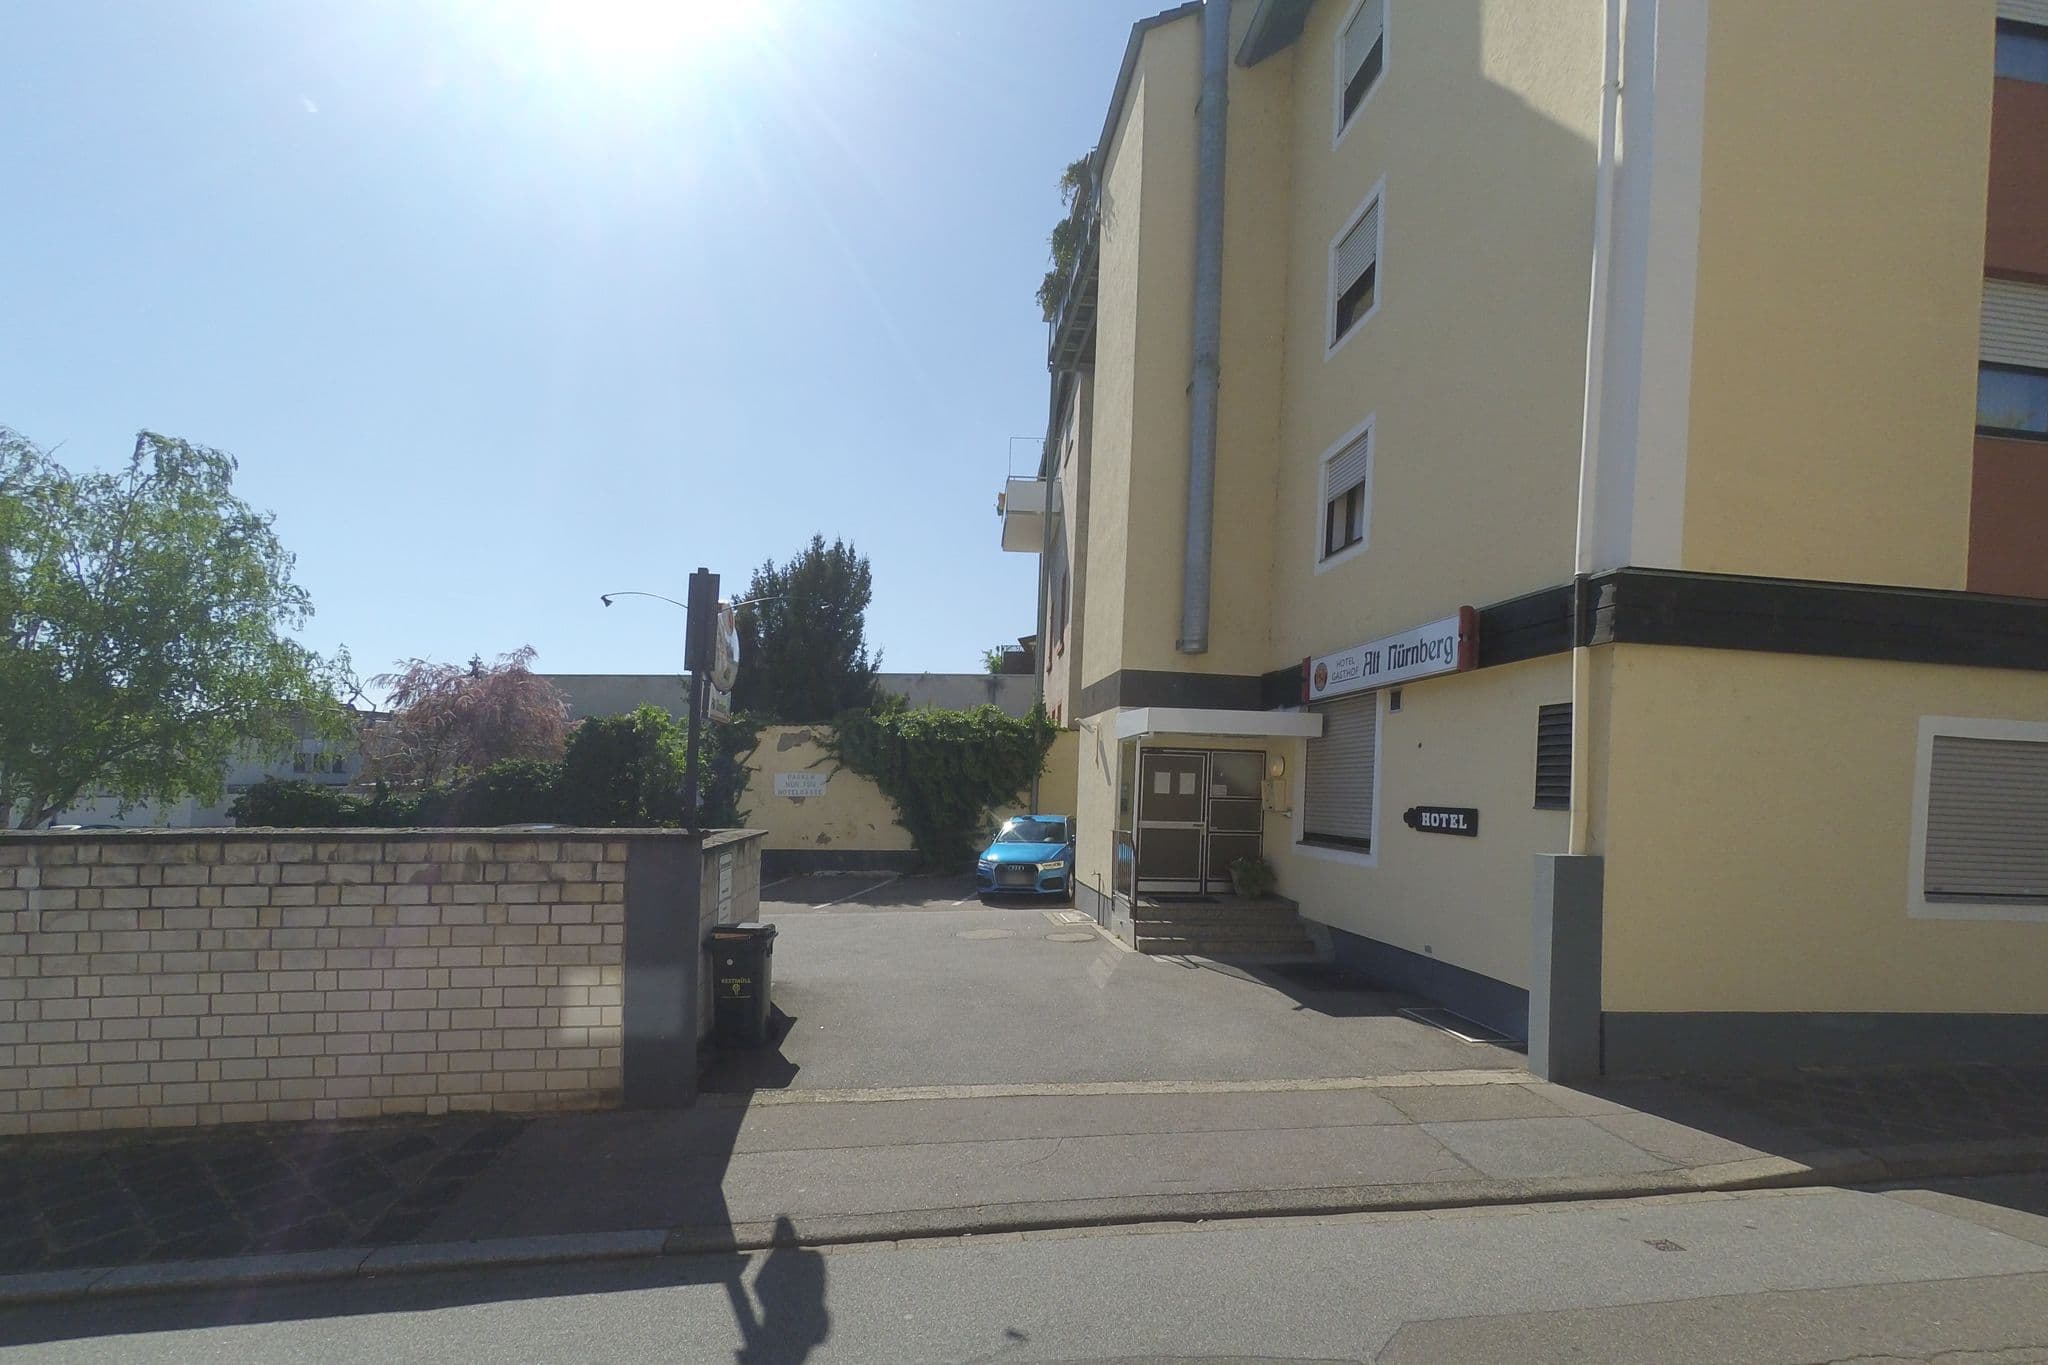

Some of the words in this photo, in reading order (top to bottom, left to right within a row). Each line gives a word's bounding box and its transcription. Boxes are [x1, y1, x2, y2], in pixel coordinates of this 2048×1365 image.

[1336, 656, 1355, 668] HOTEL
[1362, 650, 1381, 677] Alt
[1387, 635, 1454, 671] Nürnberg
[1331, 665, 1359, 681] GASTHOF
[1421, 812, 1467, 829] HOTEL
